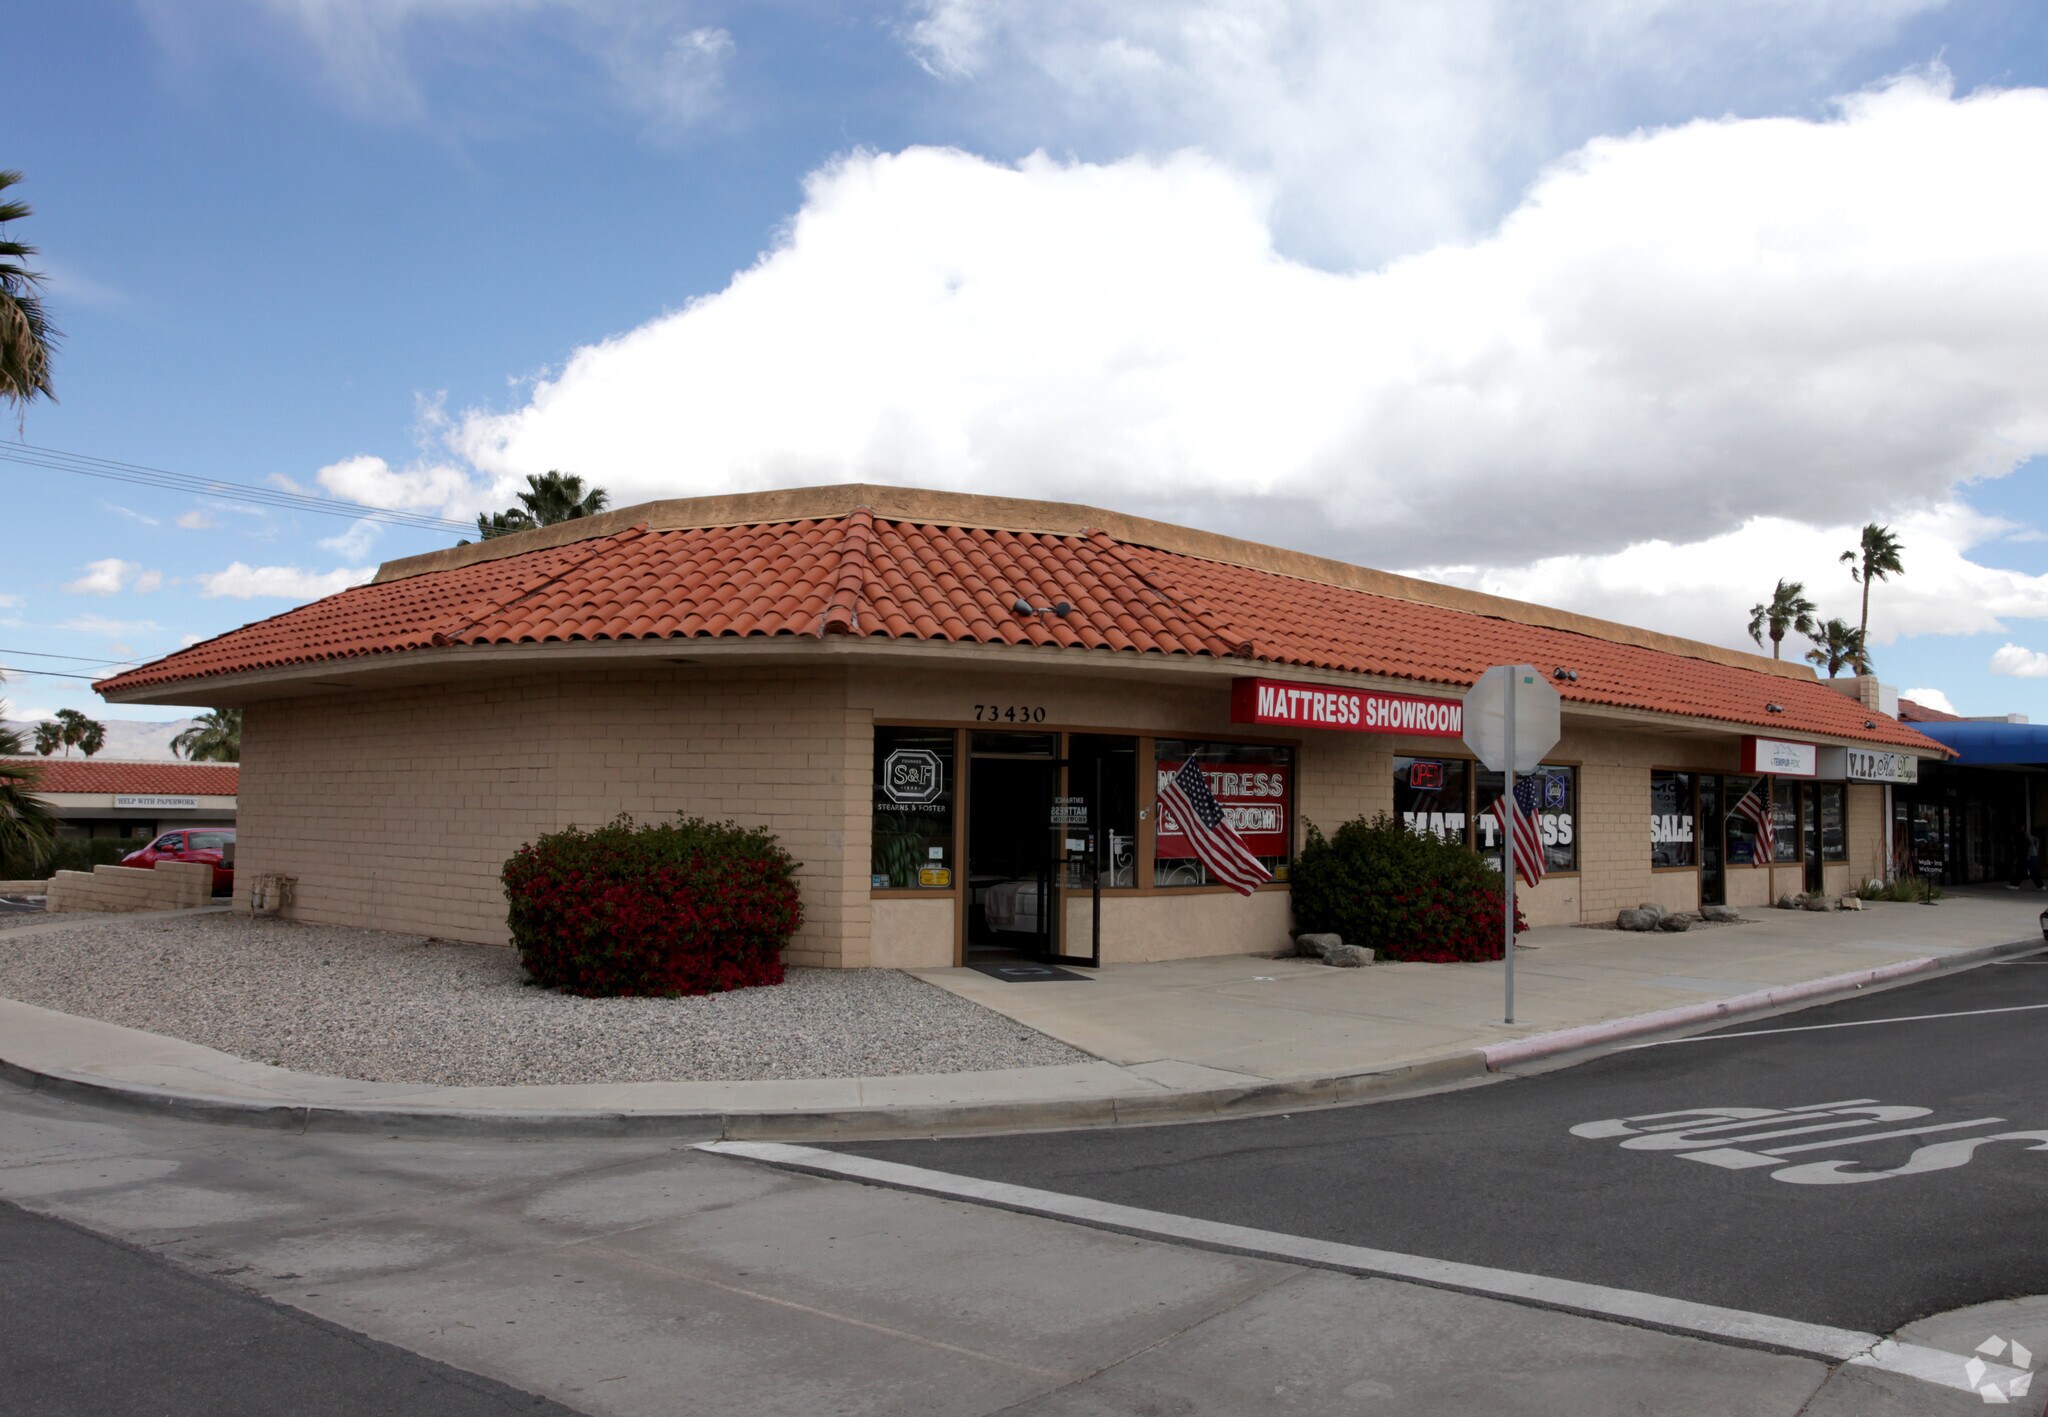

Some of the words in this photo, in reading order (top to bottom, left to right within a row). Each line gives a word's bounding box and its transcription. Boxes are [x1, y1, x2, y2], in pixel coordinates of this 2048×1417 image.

[975, 705, 1046, 723] 73430
[1258, 686, 1360, 725] MATTRESS
[1366, 698, 1462, 732] SHOWROOM
[894, 765, 933, 785] S&F
[878, 803, 909, 811] STEARNS
[1650, 814, 1693, 843] SALE
